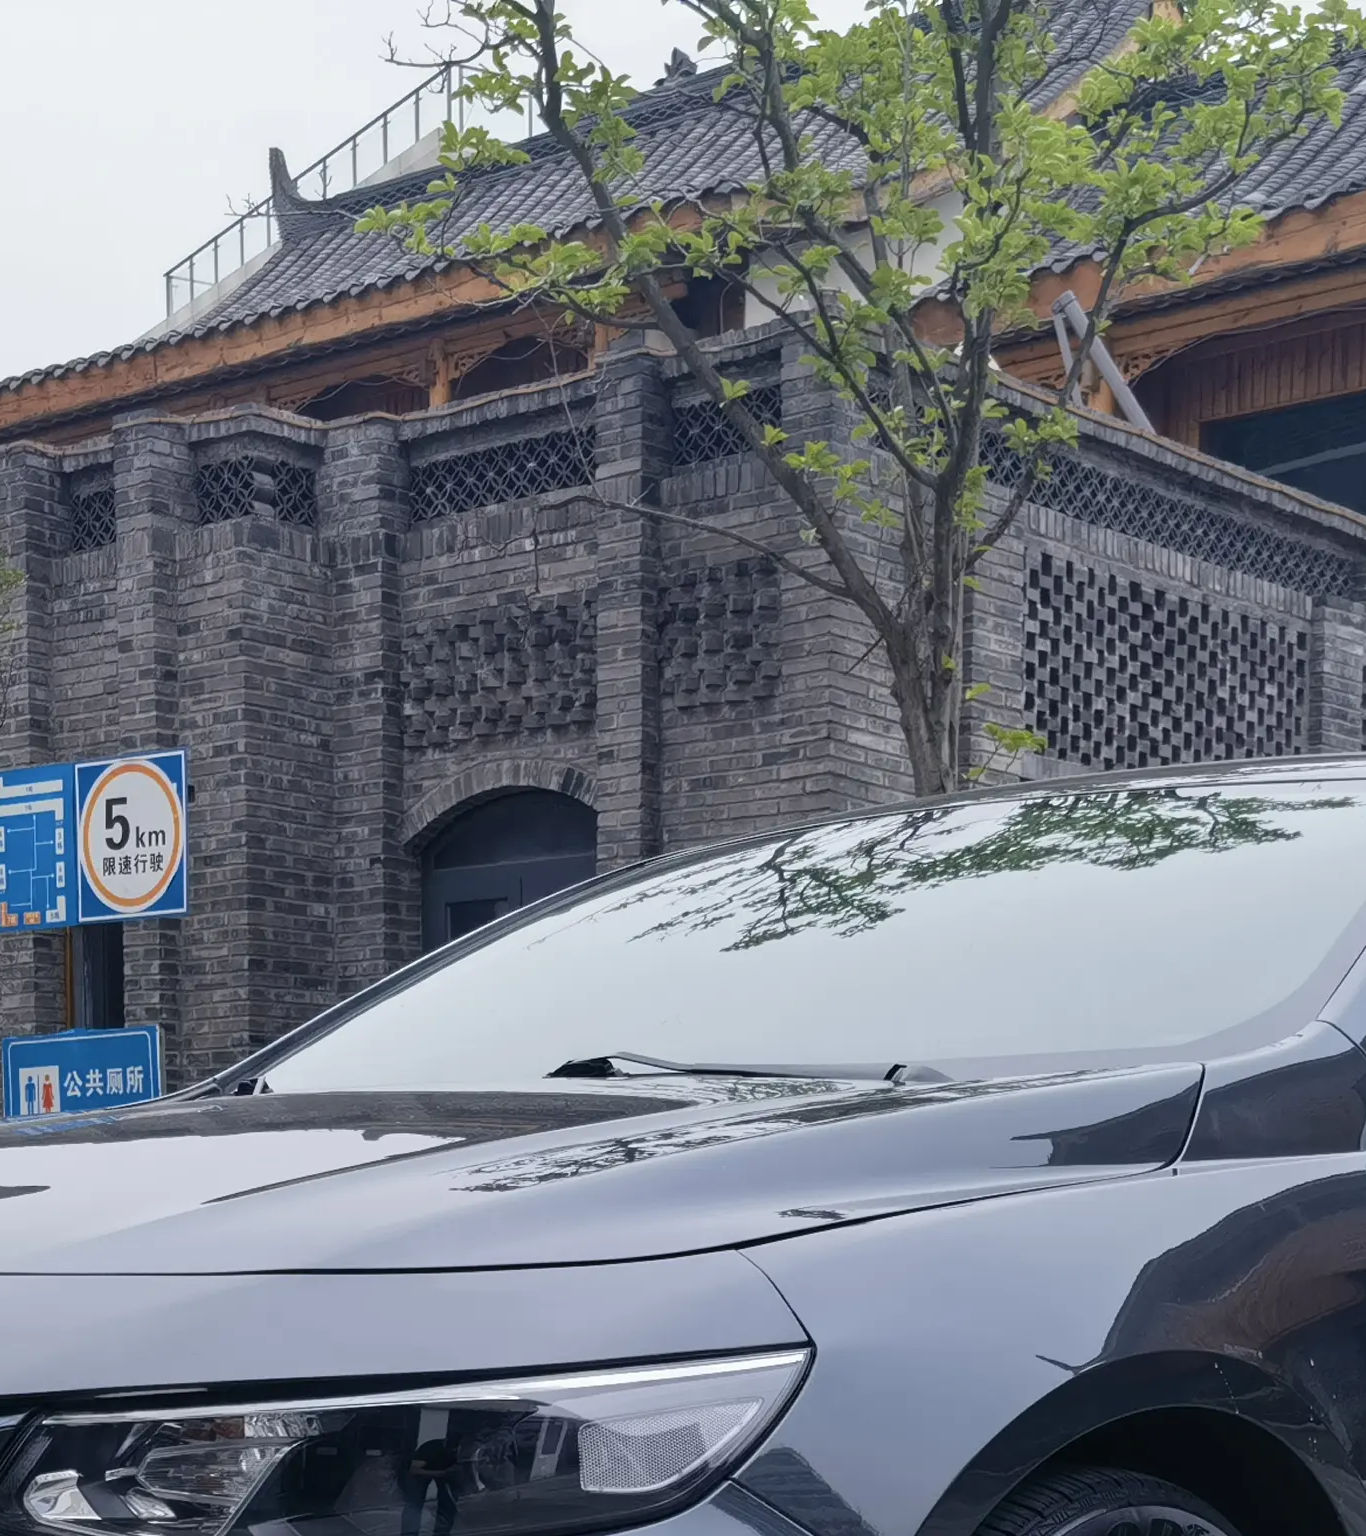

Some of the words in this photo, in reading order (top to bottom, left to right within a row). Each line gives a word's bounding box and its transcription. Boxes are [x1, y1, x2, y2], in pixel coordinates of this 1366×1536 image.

[102, 852, 164, 877] 限速行驶
[63, 1065, 145, 1098] 公共厕所
